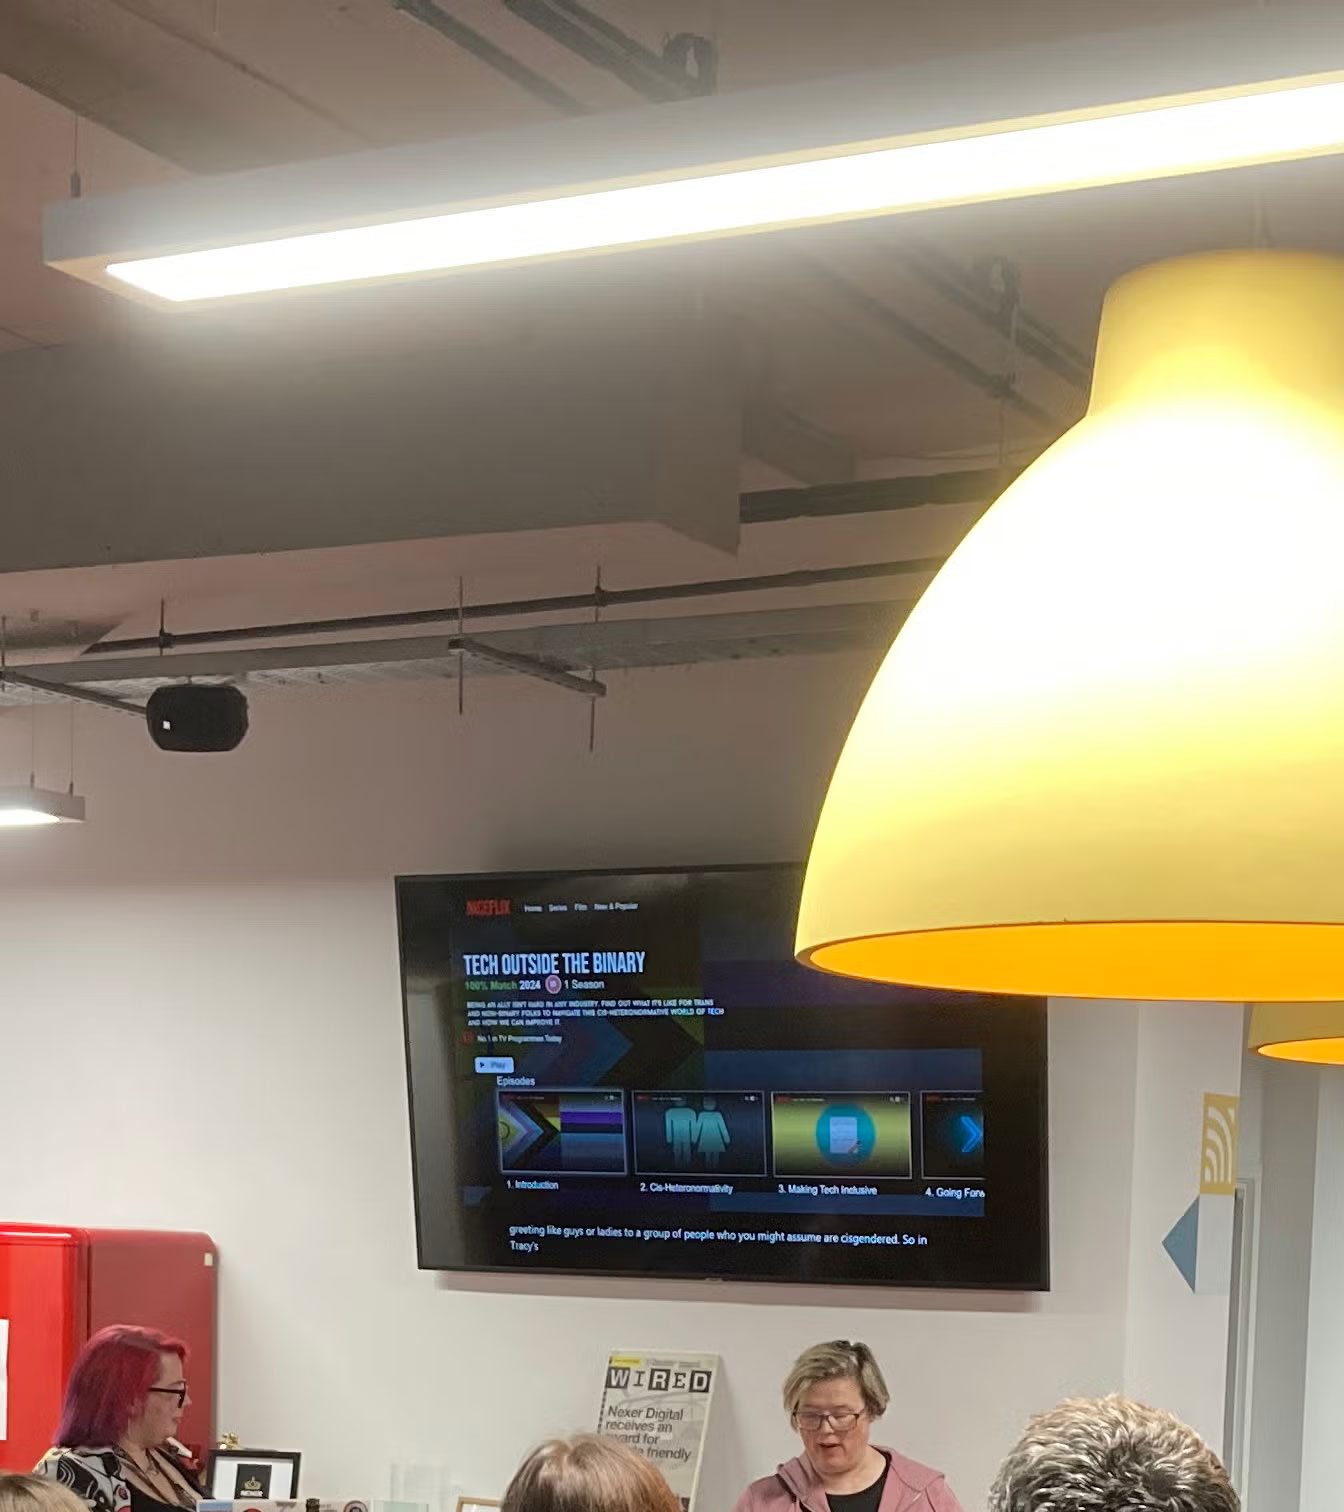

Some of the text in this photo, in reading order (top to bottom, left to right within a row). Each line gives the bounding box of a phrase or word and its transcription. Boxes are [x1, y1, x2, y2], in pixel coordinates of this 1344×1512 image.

[463, 951, 645, 975] TECH OUTSIDE THE BINARY
[490, 980, 518, 990] Match
[519, 980, 541, 990] 2024
[572, 979, 605, 990] Season
[497, 1076, 536, 1087] Episodes
[515, 1180, 559, 1190] Introduction
[640, 1182, 734, 1195] 2. Cis-Heteronormativity
[778, 1184, 878, 1196] 3. Making Tech Inclusive
[925, 1187, 935, 1197] 4.
[936, 1187, 962, 1200] Going
[509, 1225, 545, 1237] greeting
[547, 1225, 562, 1236] like
[564, 1227, 584, 1238] guys
[586, 1228, 595, 1236] or
[597, 1226, 623, 1237] ladies
[624, 1228, 634, 1237] to
[644, 1229, 670, 1240] group
[672, 1228, 682, 1239] of
[684, 1229, 715, 1241] people
[717, 1229, 736, 1240] who
[738, 1232, 756, 1243] you
[758, 1231, 785, 1244] might
[787, 1233, 821, 1242] assume
[824, 1234, 839, 1243] are
[841, 1234, 900, 1246] cisgendered.
[902, 1235, 915, 1245] So
[917, 1235, 928, 1245] in
[510, 1240, 539, 1252] Tracy's
[606, 1367, 712, 1393] WIRED
[608, 1405, 684, 1422] Nexer Digital
[606, 1421, 673, 1432] receives an
[643, 1433, 660, 1444] for
[647, 1446, 692, 1462] friendly
